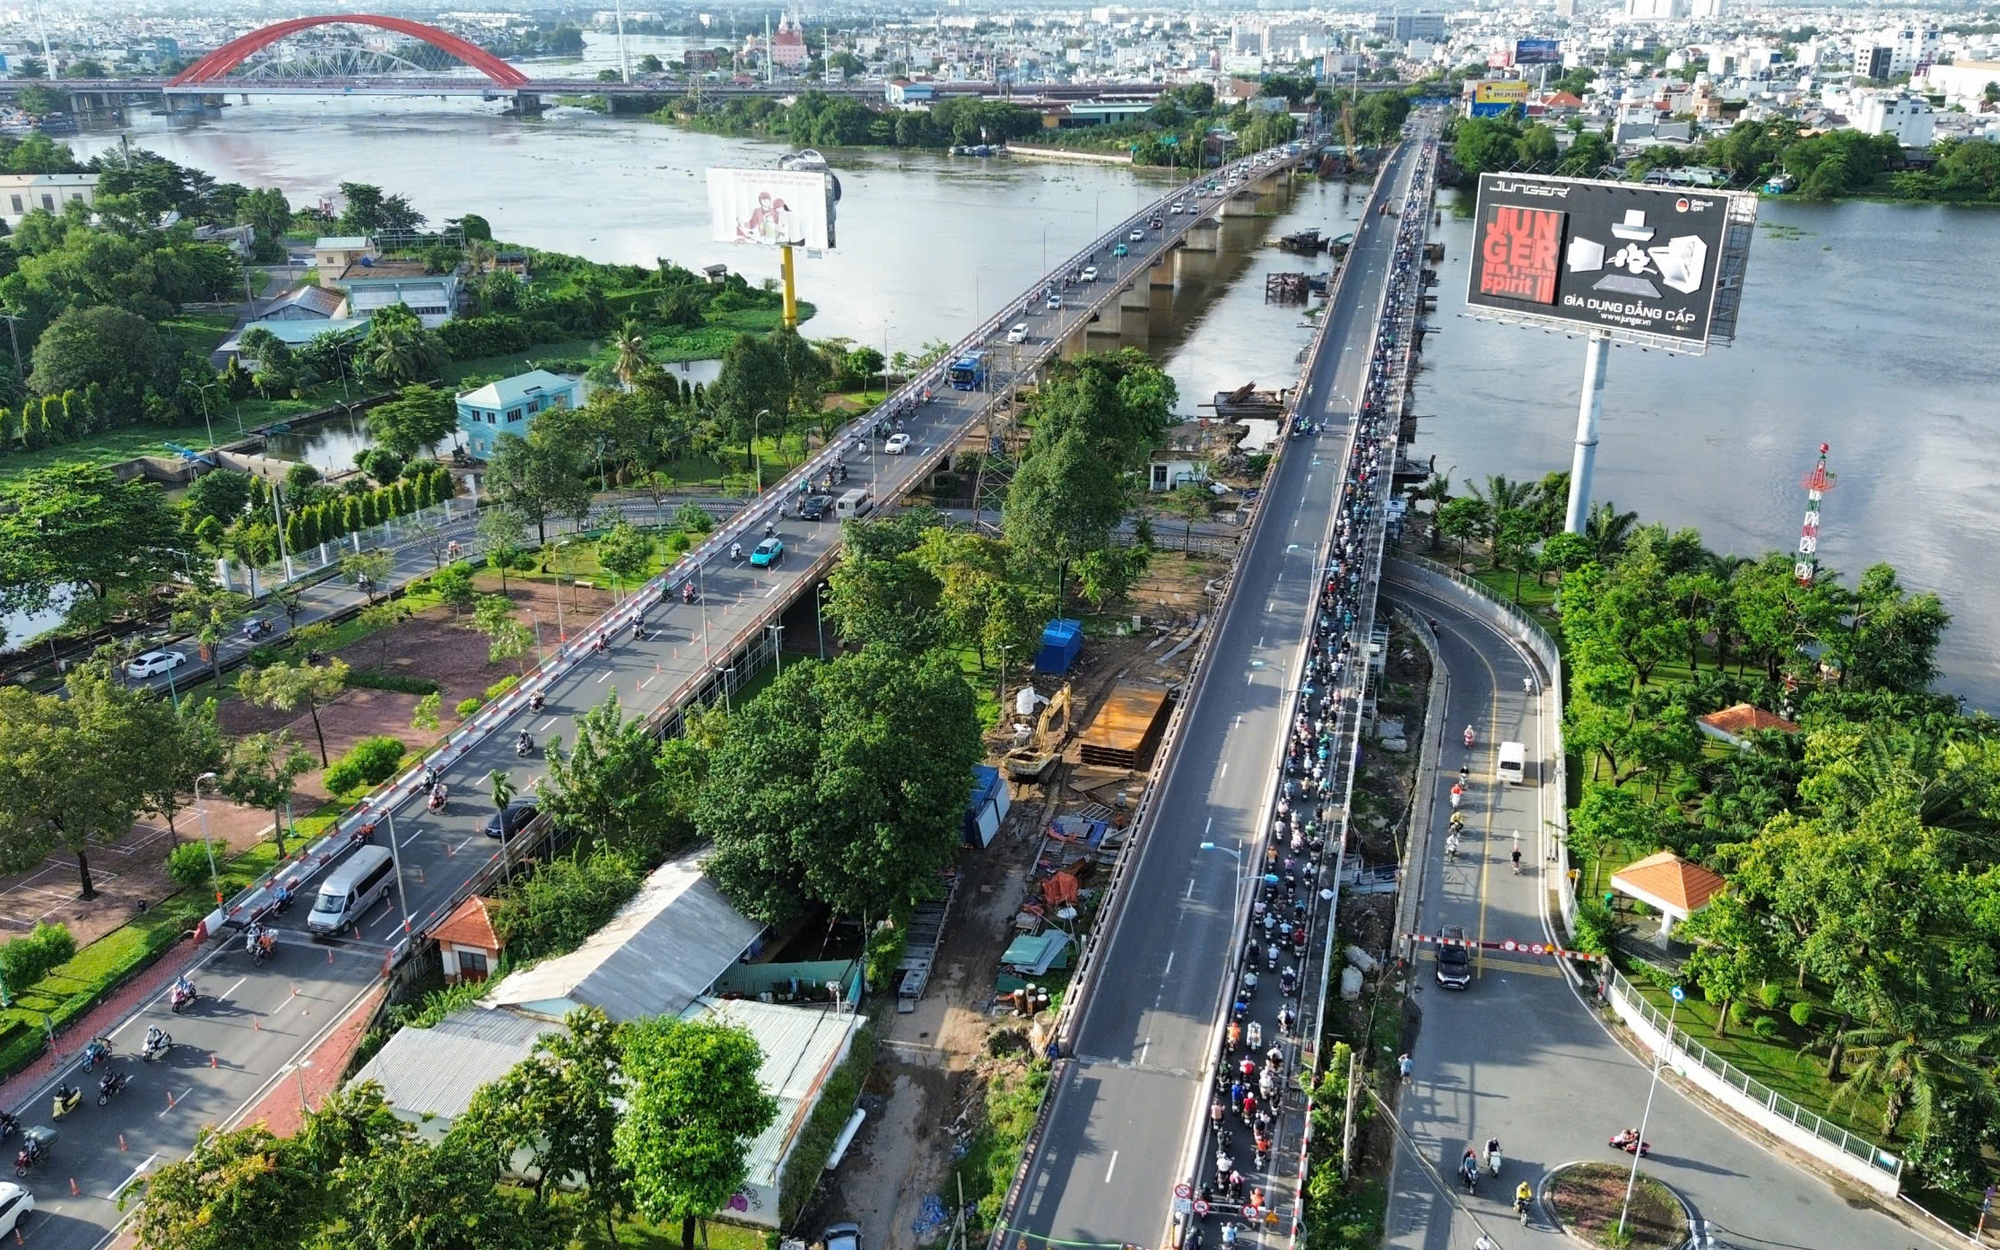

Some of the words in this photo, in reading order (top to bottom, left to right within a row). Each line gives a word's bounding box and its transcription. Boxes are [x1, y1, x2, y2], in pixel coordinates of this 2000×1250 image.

[1489, 181, 1567, 198] JUNGER
[1486, 206, 1558, 241] JUN
[1483, 233, 1557, 272] GER
[1587, 298, 1623, 313] DỤNG
[1665, 307, 1696, 323] CẤP
